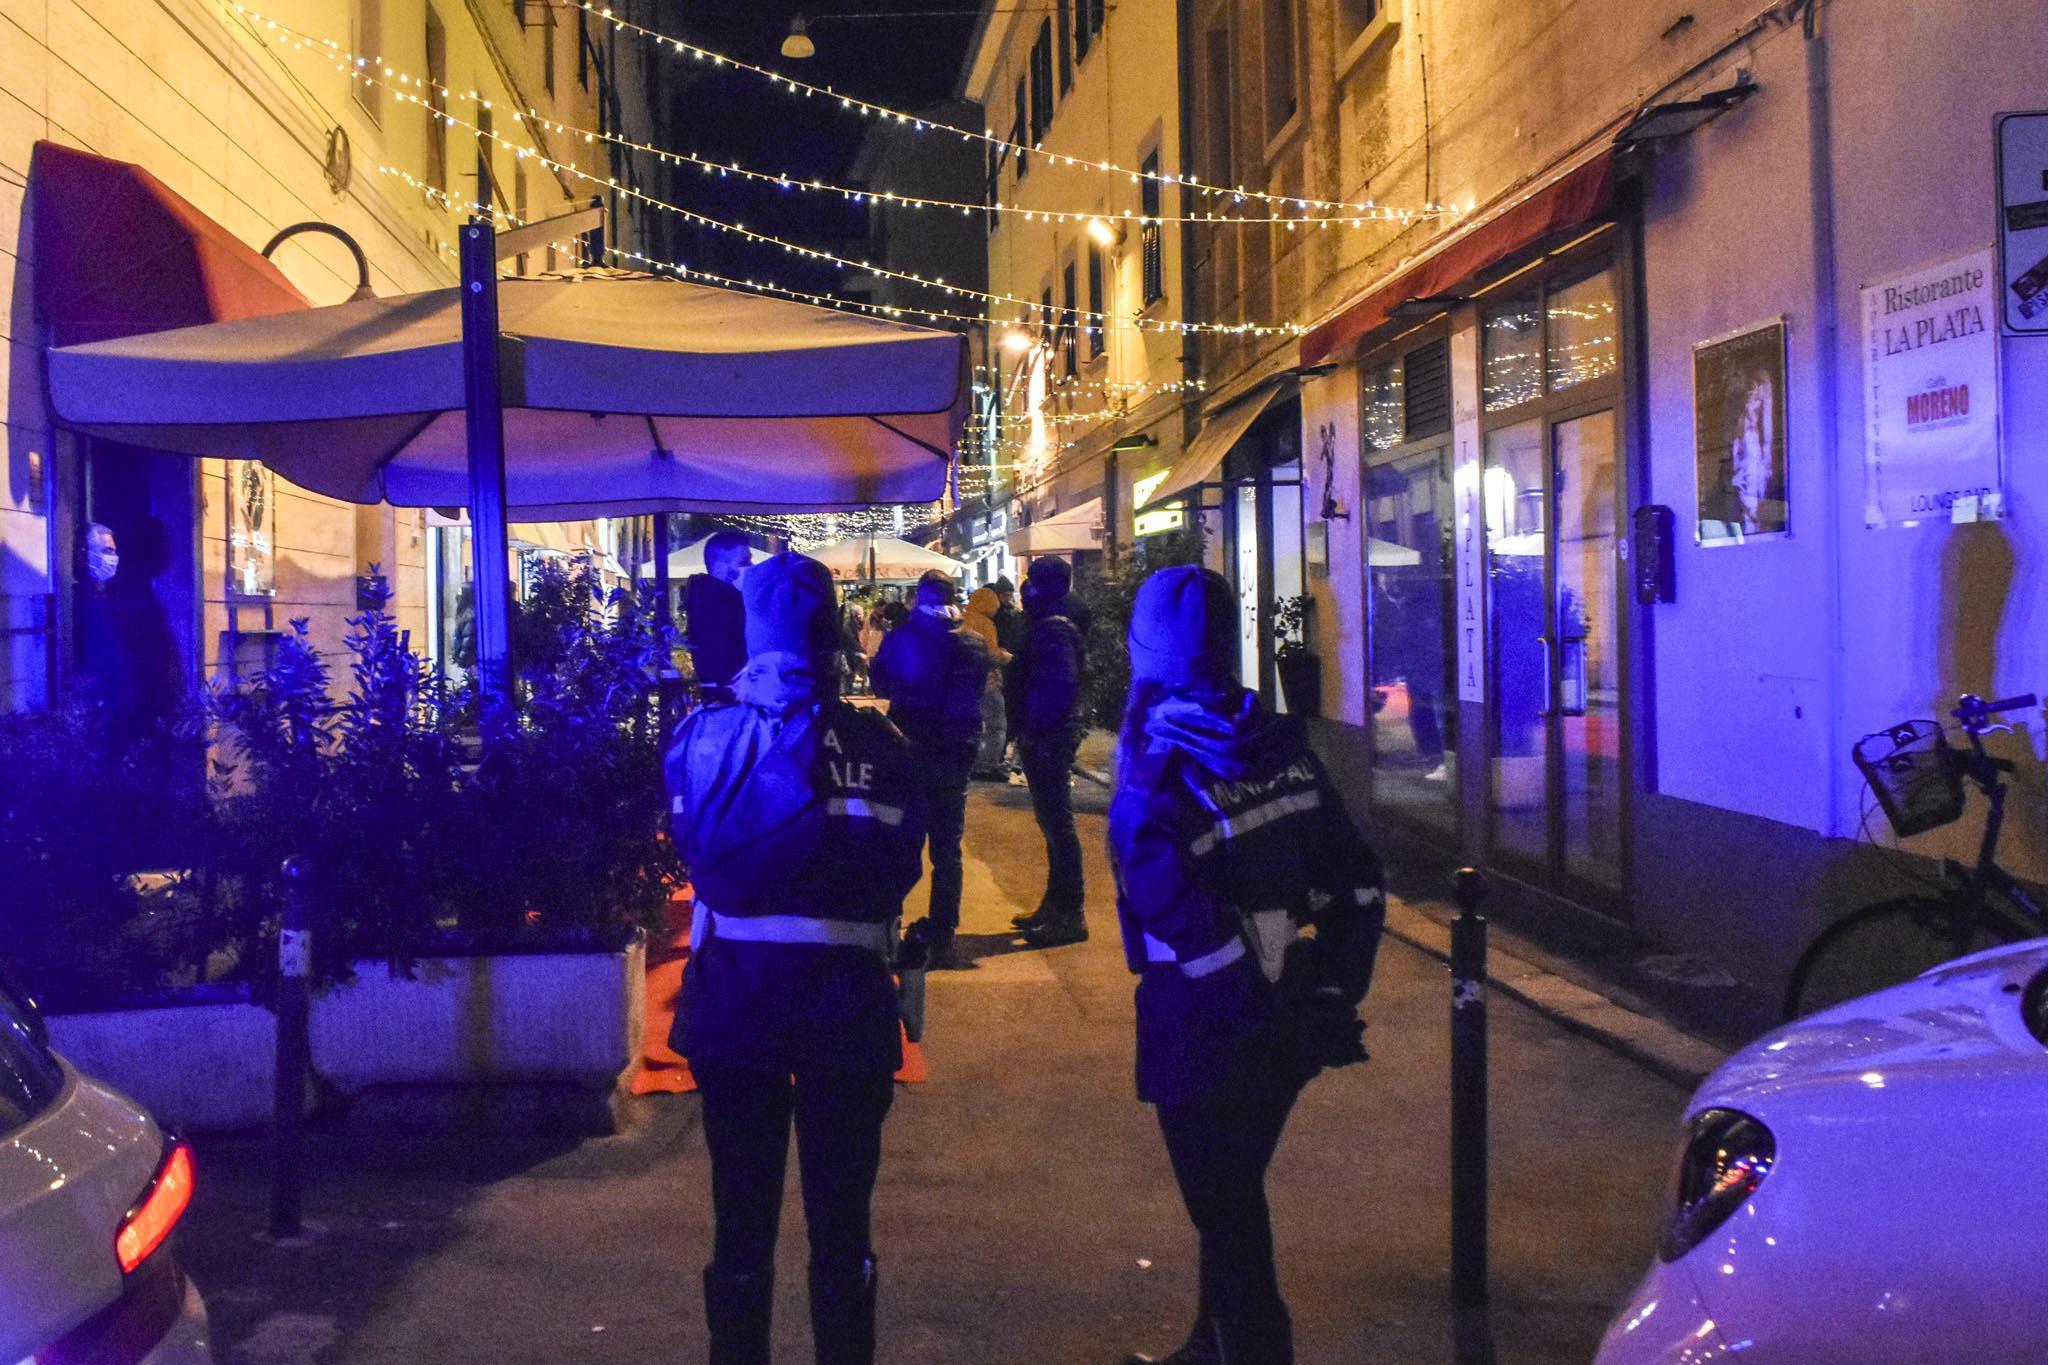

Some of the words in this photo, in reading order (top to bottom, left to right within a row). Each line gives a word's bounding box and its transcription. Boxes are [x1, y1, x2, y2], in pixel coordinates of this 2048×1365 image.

[1884, 269, 1983, 315] Ristorante
[1884, 326, 1912, 356] LA
[1916, 305, 1985, 348] PLATA
[1907, 384, 1969, 425] MORENO
